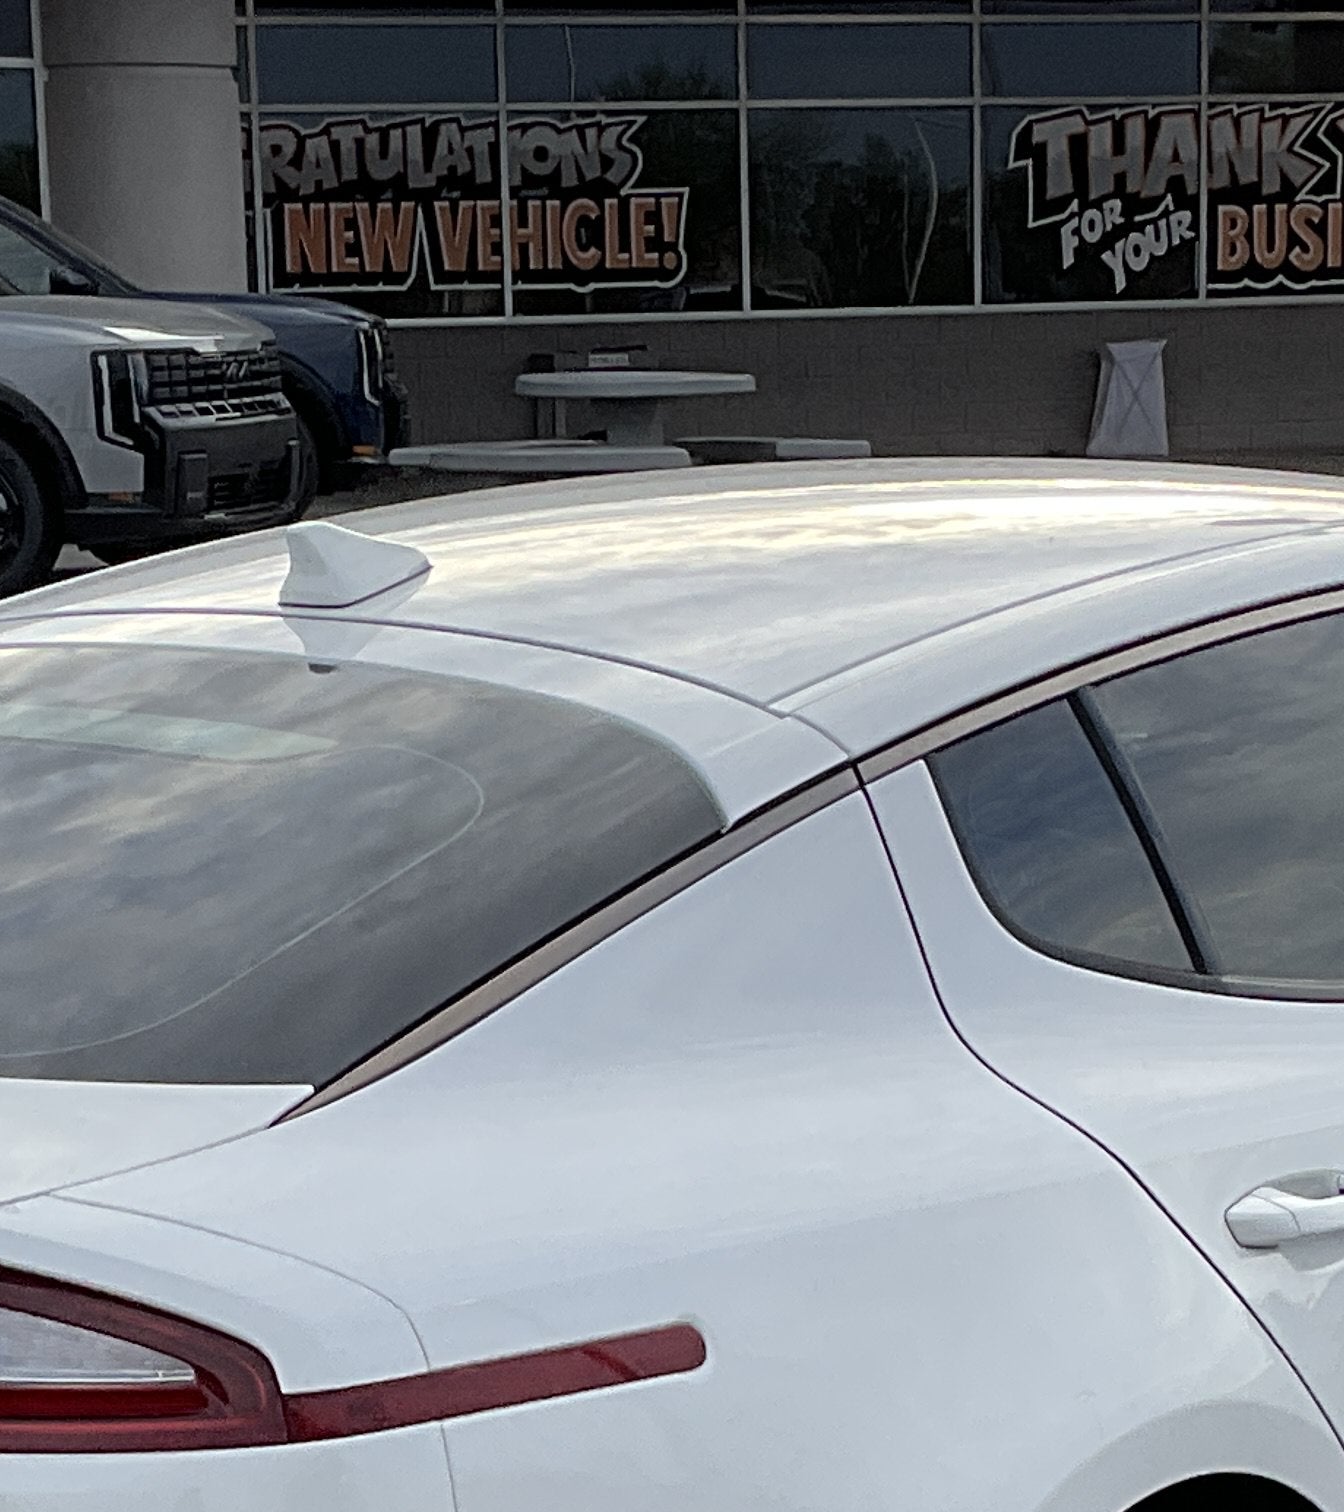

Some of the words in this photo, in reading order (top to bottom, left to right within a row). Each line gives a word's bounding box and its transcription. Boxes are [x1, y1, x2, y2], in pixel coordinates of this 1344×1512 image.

[241, 119, 637, 195] RATULATIONS
[1032, 107, 1323, 199] THANK
[283, 202, 415, 273] NEW
[434, 196, 680, 272] VEHICLE!
[1060, 198, 1124, 270] FOR
[1101, 209, 1195, 294] YOUR
